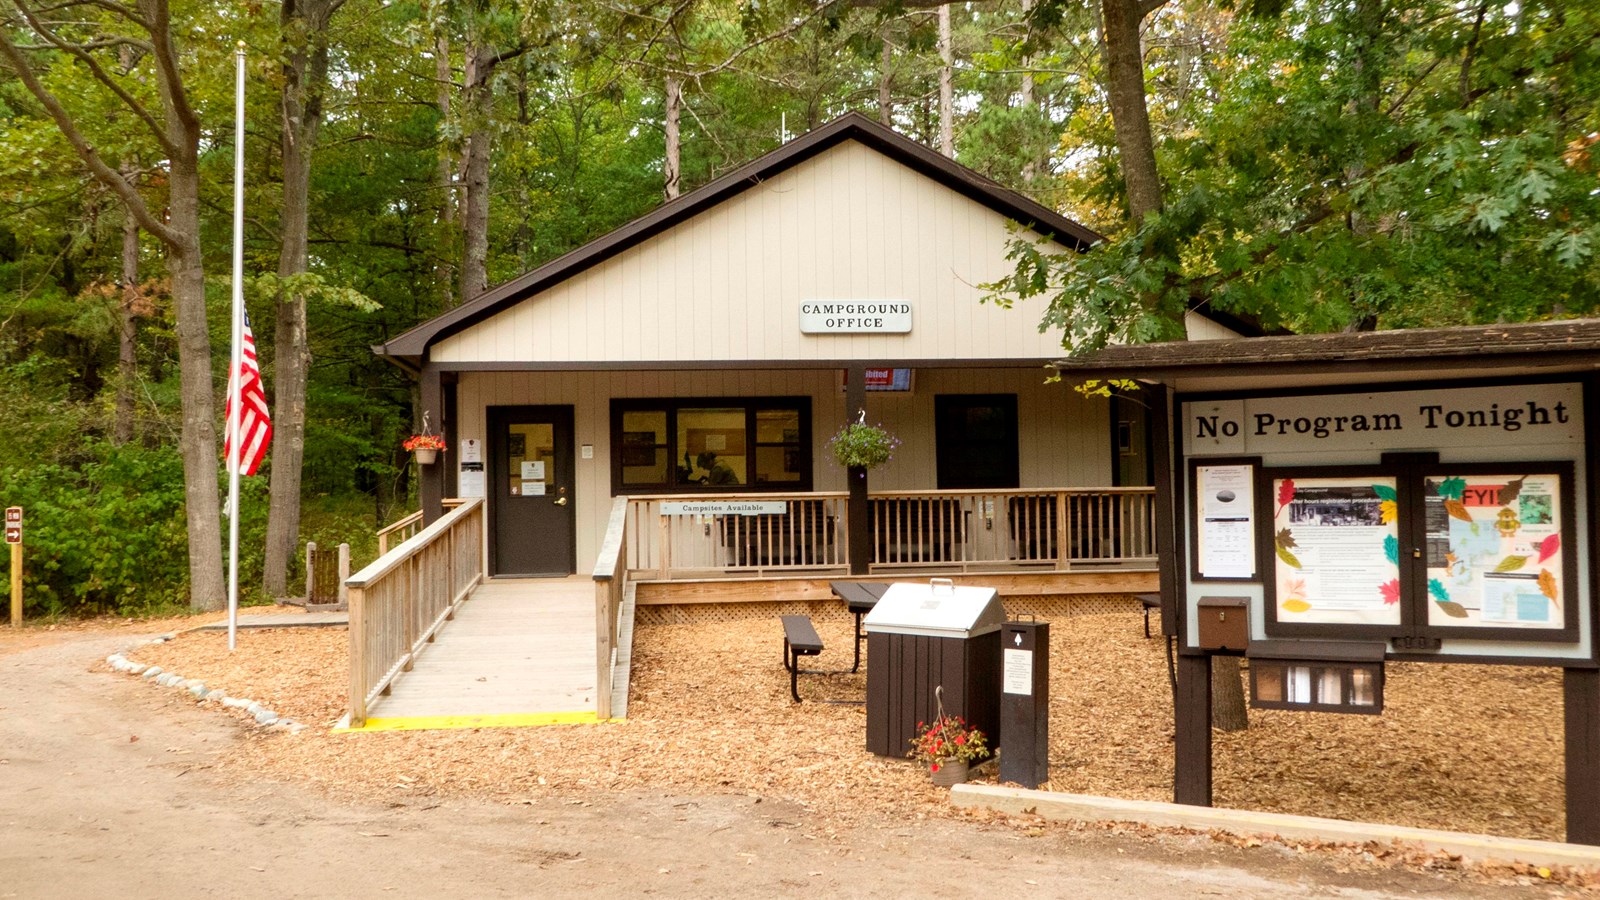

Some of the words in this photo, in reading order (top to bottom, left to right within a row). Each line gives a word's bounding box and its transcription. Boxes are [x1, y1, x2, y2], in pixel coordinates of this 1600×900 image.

[802, 304, 909, 314] CAMPGROUND
[825, 318, 883, 328] OFFICE
[1196, 416, 1239, 438] No
[1254, 412, 1402, 438] Program
[1419, 401, 1569, 431] Tonight
